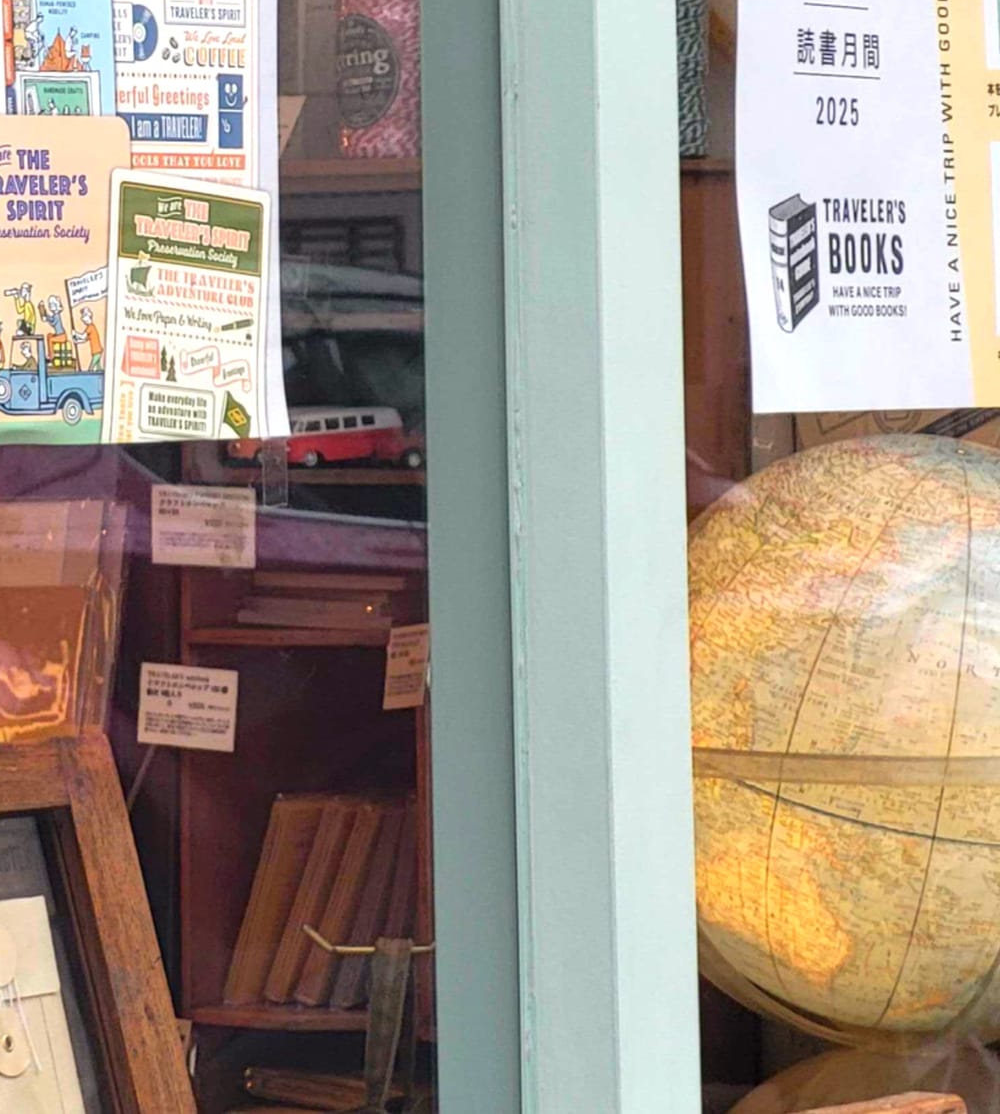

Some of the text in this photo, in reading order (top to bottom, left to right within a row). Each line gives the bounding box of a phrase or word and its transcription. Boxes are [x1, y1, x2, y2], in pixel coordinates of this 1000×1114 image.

[170, 6, 241, 21] TRAVELER'S SPIRIT
[183, 46, 246, 68] COFFEE
[797, 28, 880, 70] 読書月間
[152, 83, 210, 110] Greetings
[939, 62, 954, 123] WITH
[816, 96, 859, 127] 2025
[131, 116, 136, 138] I
[137, 120, 150, 138] am
[153, 122, 159, 137] a
[17, 149, 50, 170] THE
[942, 133, 956, 183] TRIP
[6, 200, 64, 221] SPIRIT
[184, 199, 209, 223] THE
[823, 198, 906, 224] TRAVELER'S
[945, 193, 958, 247] NICE
[53, 224, 89, 244] Society
[134, 214, 250, 252] TRAVELER'S SPIRIT
[147, 239, 238, 269] Preservation Society
[829, 233, 904, 275] BOOKS
[947, 259, 959, 272] A
[157, 267, 254, 294] THE TRAVELER'S
[833, 286, 901, 298] HAVE A NICE TRIP
[157, 284, 254, 308] ADVENTURE CLUB
[153, 310, 212, 334] Paper Writing
[828, 304, 907, 317] WITH GOOD BOOKS!
[949, 282, 962, 342] HAVE
[158, 405, 191, 418] adventure
[167, 394, 195, 408] everyday
[148, 415, 183, 430] TRAVELER'S
